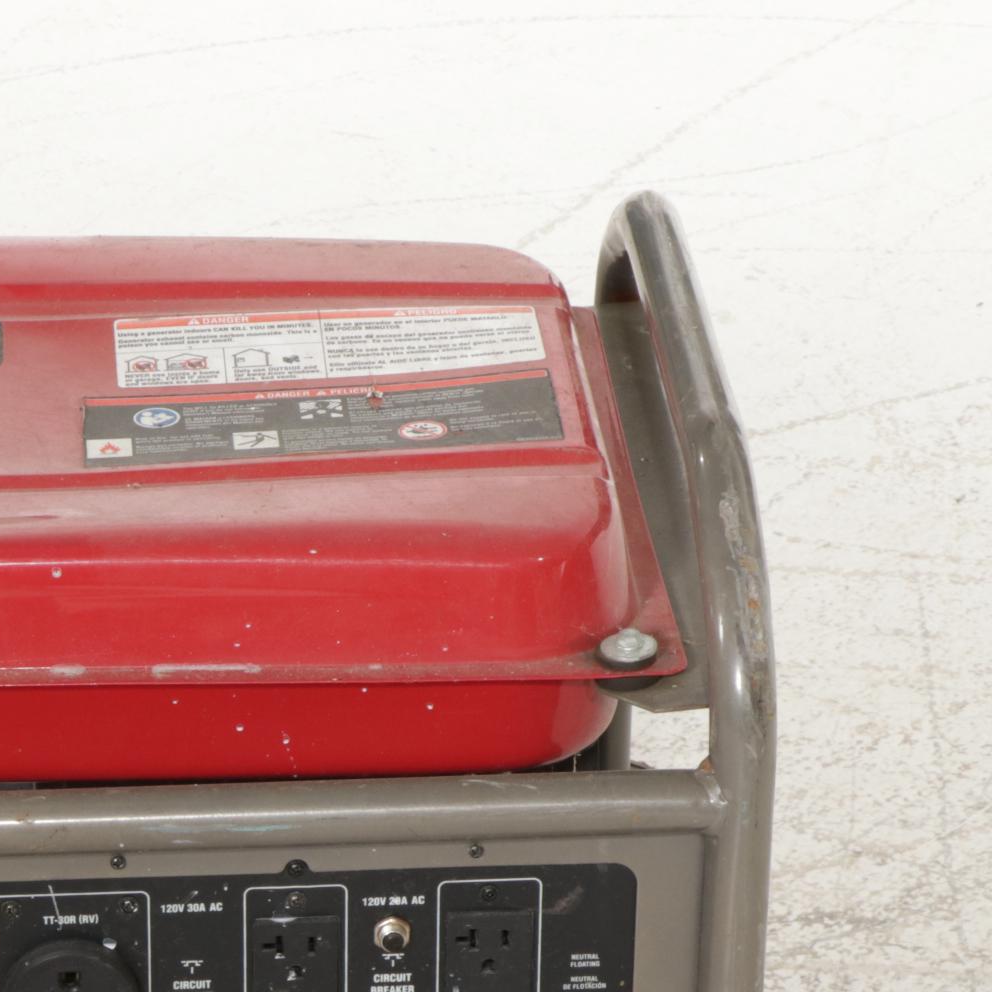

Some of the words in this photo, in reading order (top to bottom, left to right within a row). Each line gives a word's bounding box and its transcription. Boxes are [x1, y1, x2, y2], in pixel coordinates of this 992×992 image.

[202, 316, 249, 324] DANGER
[267, 391, 310, 399] DANGER
[361, 896, 387, 906] 120V
[411, 895, 425, 905] AC
[160, 903, 184, 913] 120V
[186, 903, 206, 913] 30A
[209, 902, 223, 912] AC
[42, 915, 77, 925] TT-30R
[78, 913, 99, 925] (RV)
[569, 960, 601, 968] FLOATING
[373, 973, 412, 983] CIRCUIT
[172, 979, 212, 990] CIRCUIT
